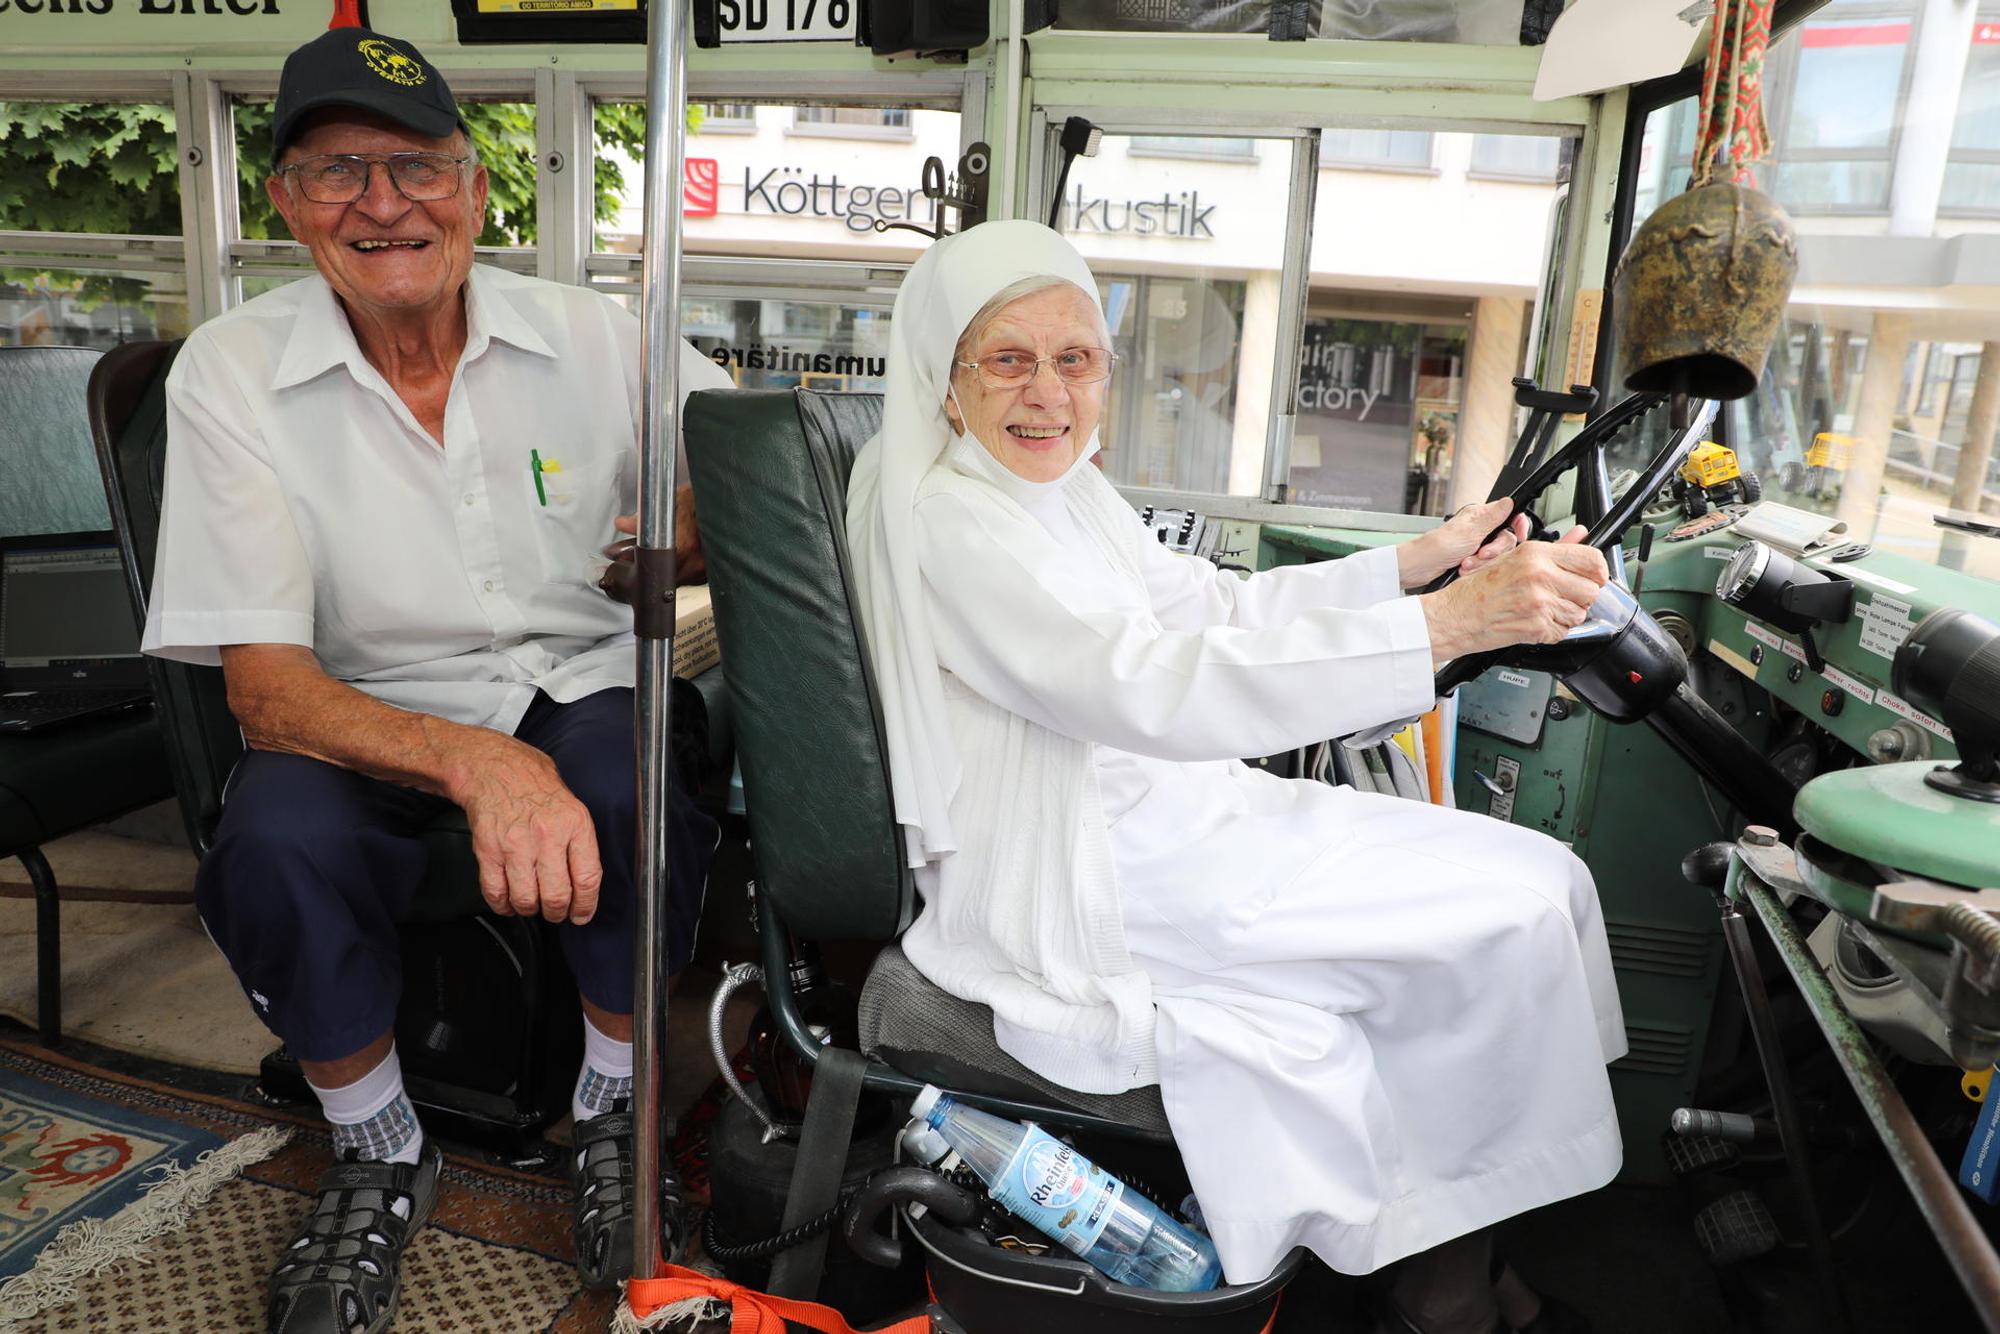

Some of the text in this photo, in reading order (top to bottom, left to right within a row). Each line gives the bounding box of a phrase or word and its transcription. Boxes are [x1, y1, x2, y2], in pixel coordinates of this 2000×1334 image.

[744, 166, 1217, 238] Köttgen kustik
[1881, 695, 1906, 713] Choke
[1910, 710, 1937, 729] sofort
